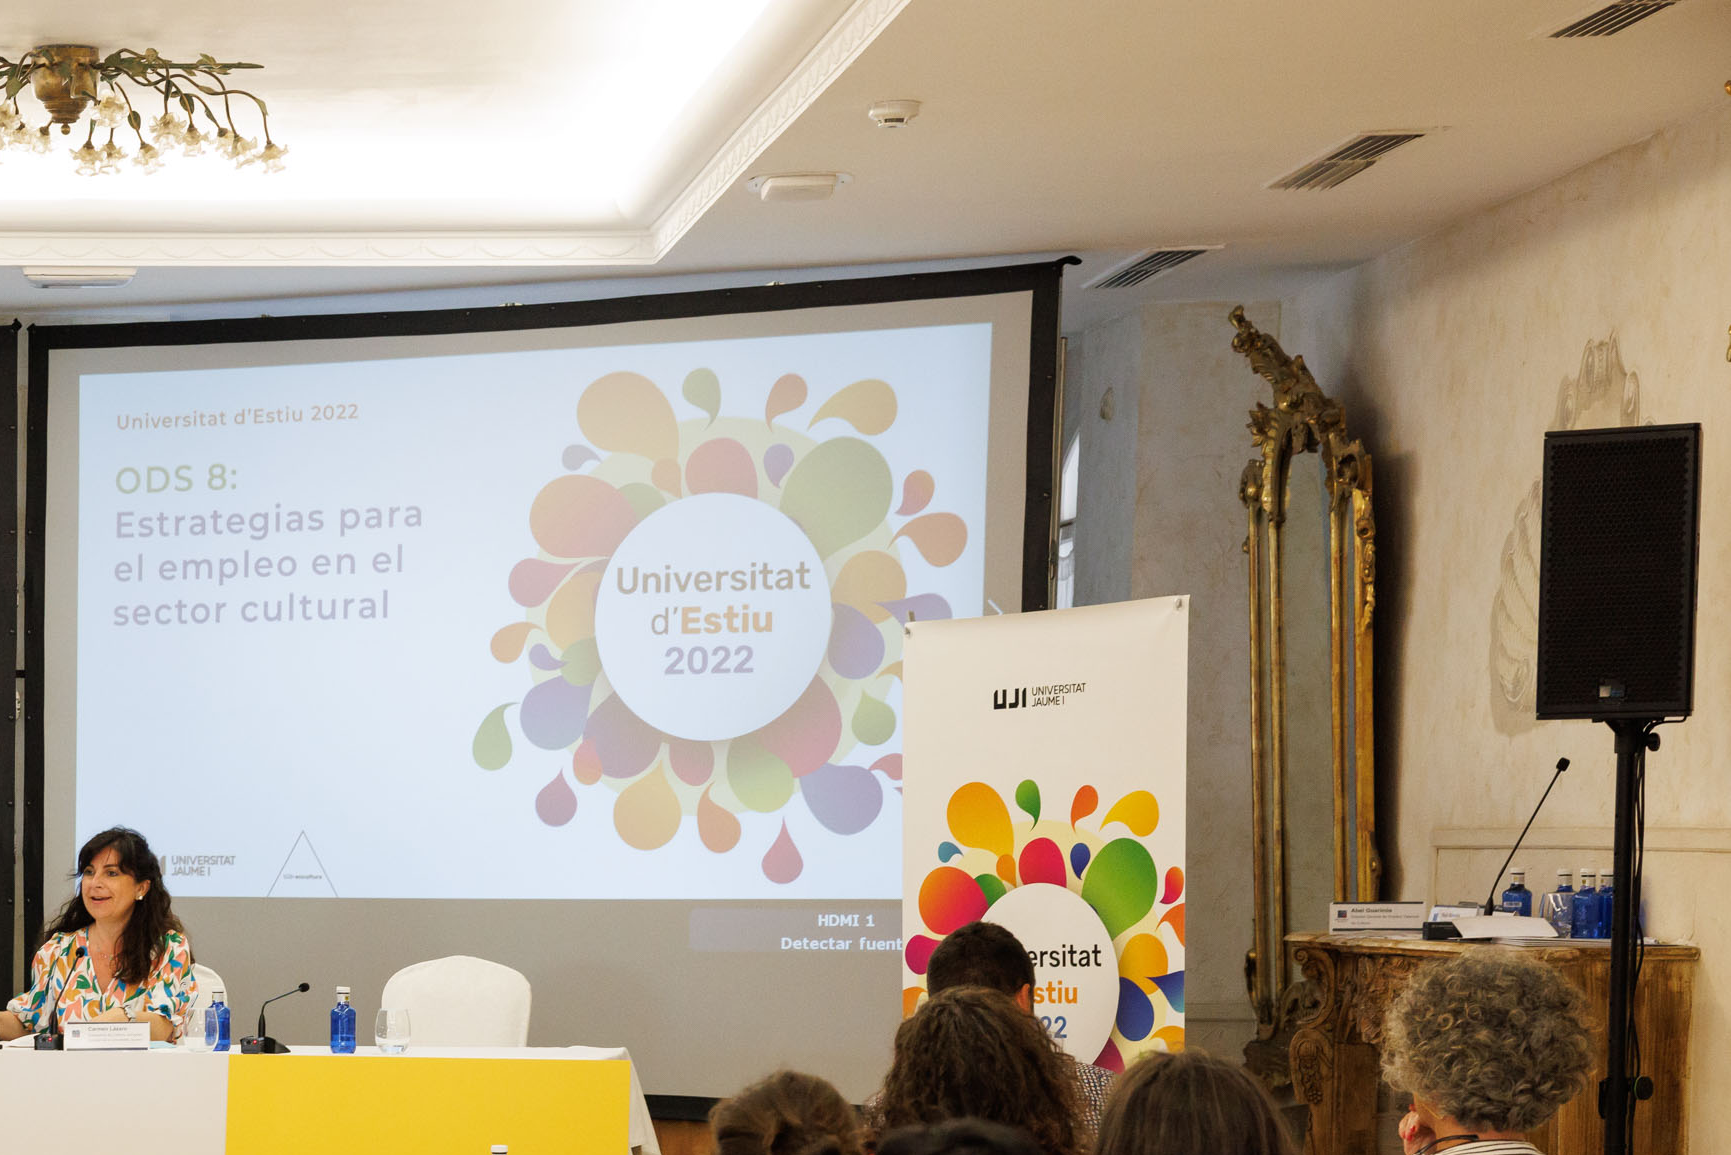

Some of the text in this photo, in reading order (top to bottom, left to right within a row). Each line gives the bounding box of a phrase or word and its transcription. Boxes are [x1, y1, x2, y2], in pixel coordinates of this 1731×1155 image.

[116, 410, 227, 430] Universitat
[311, 404, 359, 422] 2022
[115, 463, 238, 494] ODS 8:
[116, 503, 424, 541] Estrategias para
[114, 543, 404, 586] el empleo en el
[616, 560, 811, 596] Universitat
[113, 589, 389, 626] sector cultural
[664, 646, 755, 676] 2022
[993, 682, 1086, 710] UJI UNIVERSITAT
[1031, 695, 1061, 707] JAUME
[171, 855, 236, 866] UNIVERSITAT
[171, 866, 205, 877] JAUME
[817, 914, 876, 927] HDMI 1
[780, 936, 903, 951] Detectar fuent
[1028, 943, 1102, 968] ersitat
[1033, 980, 1078, 1004] stiu
[1040, 1015, 1068, 1039] 22
